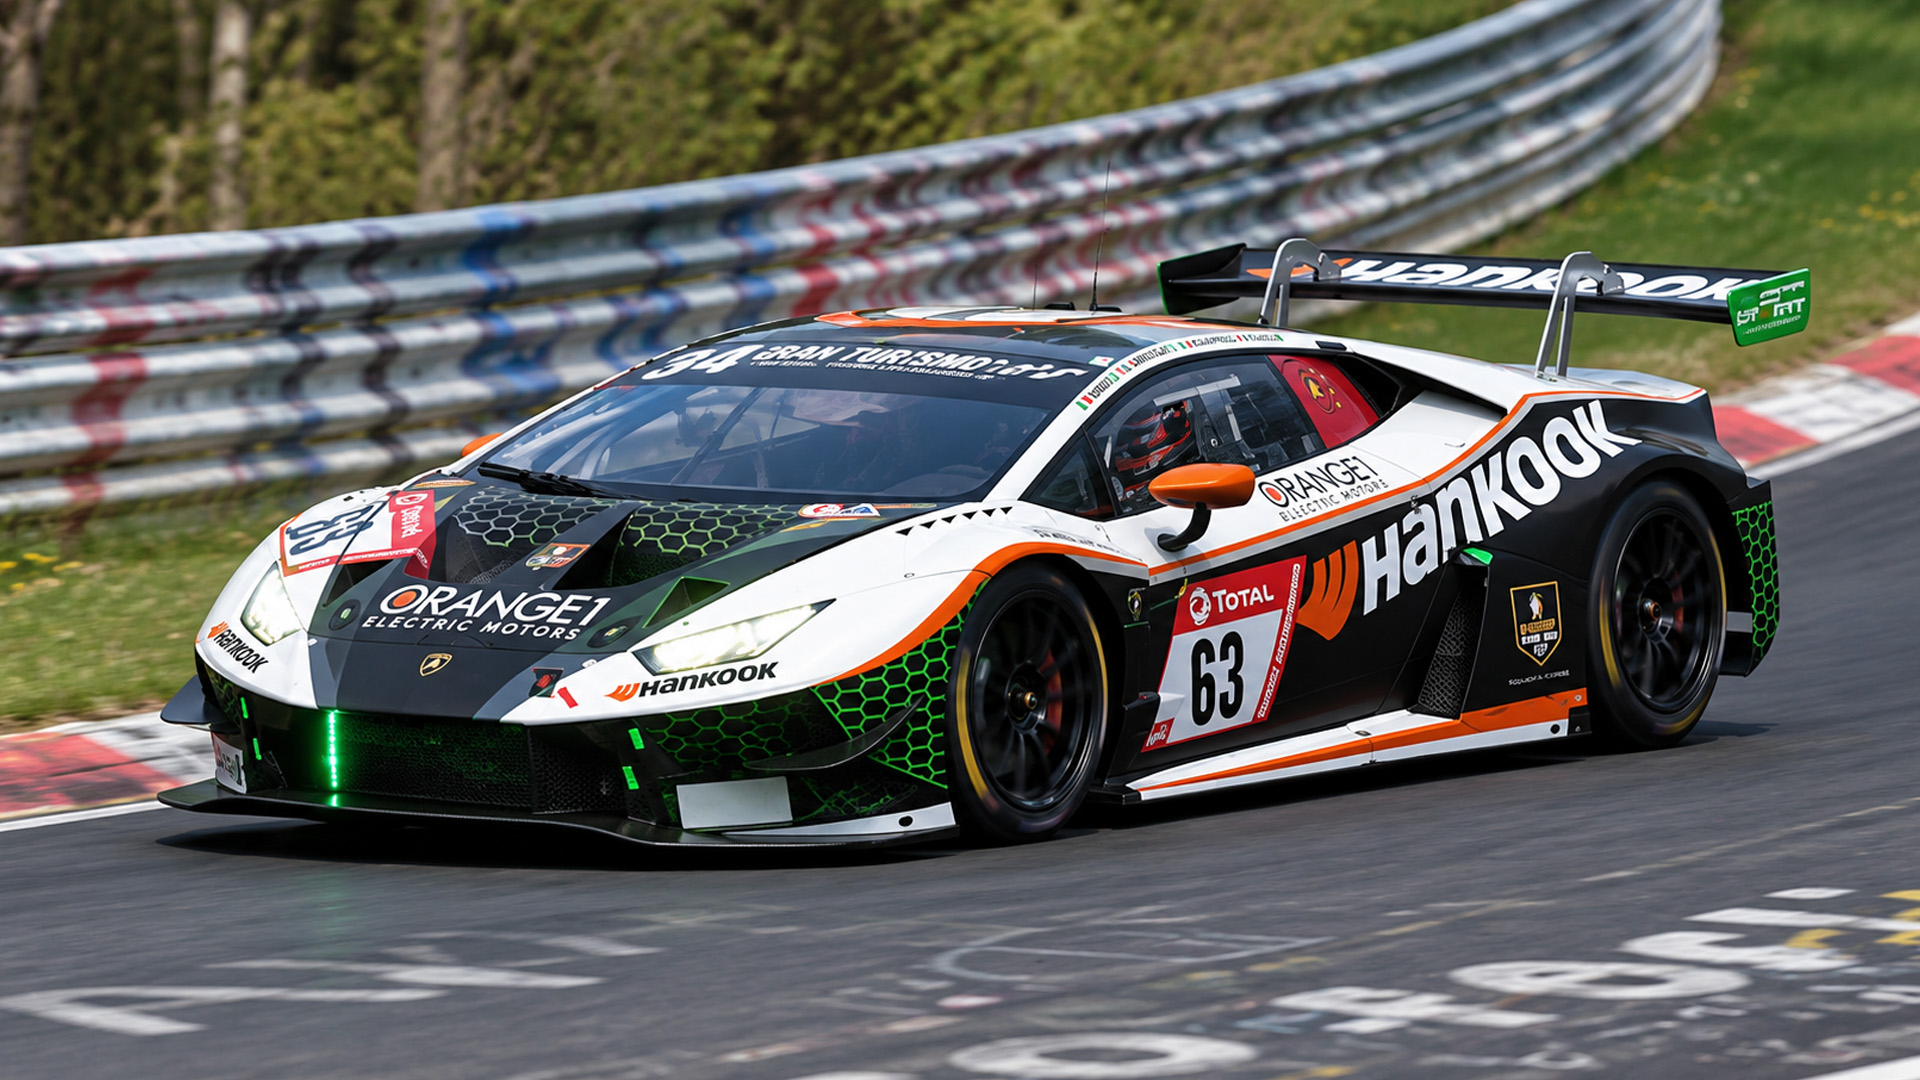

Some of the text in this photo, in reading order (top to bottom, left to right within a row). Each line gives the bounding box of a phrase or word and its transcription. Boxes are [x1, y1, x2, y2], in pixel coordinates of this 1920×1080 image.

[641, 345, 764, 380] 34
[1258, 456, 1379, 508] ORANGE1
[379, 584, 611, 627] ORANGE1
[1212, 584, 1275, 613] TOTAL
[362, 615, 582, 641] ELECTRIC MOTORS
[1191, 631, 1244, 726] 63
